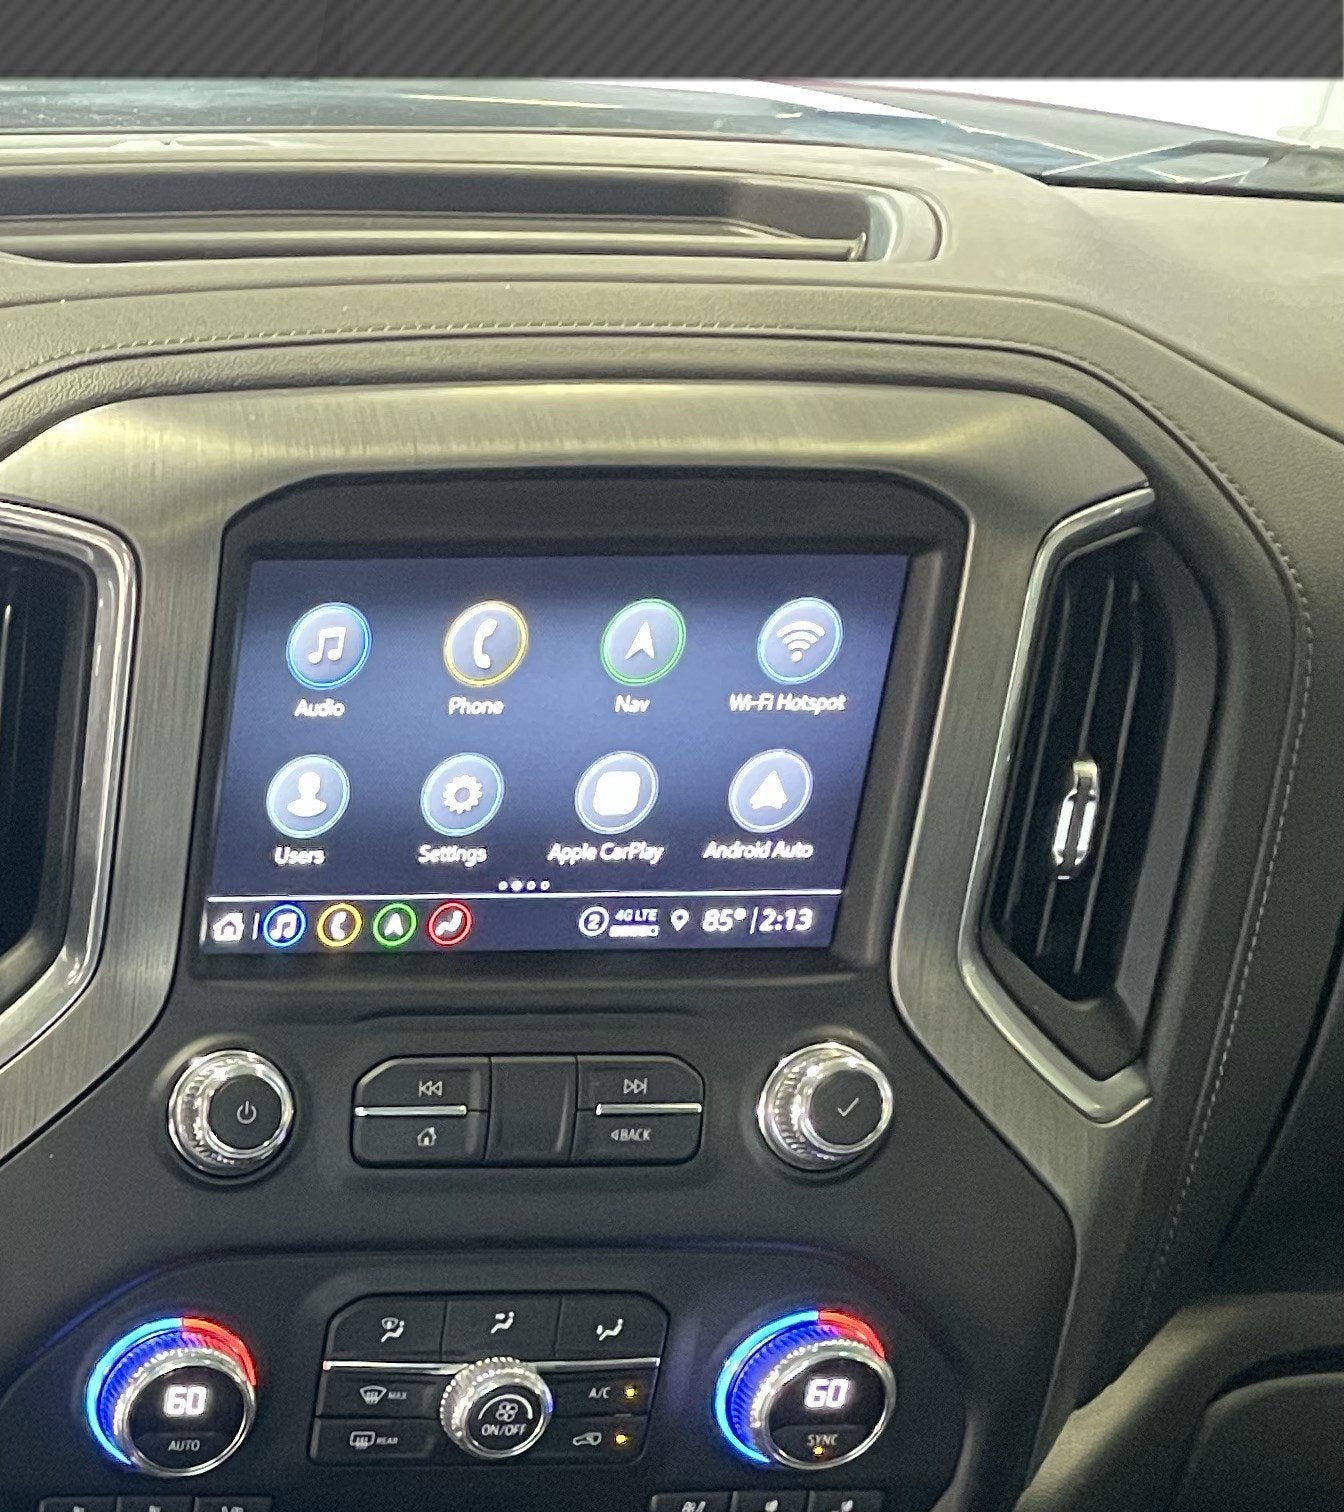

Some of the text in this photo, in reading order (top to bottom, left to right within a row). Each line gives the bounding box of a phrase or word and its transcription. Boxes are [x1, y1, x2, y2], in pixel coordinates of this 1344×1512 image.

[293, 698, 346, 718] Audio
[448, 696, 505, 715] Phone
[613, 694, 651, 713] Nav
[728, 693, 847, 715] Wi-Fi Hotspot
[274, 846, 326, 866] Users
[418, 844, 488, 868] Settings
[546, 842, 665, 865] Apple CarPlay
[702, 841, 814, 860] Android Auto
[759, 907, 813, 931] 2:13
[620, 1128, 652, 1141] BACK
[164, 1385, 209, 1417] 60
[589, 1387, 611, 1399] A/C
[804, 1378, 849, 1408] 60
[481, 1424, 527, 1436] ON/OFF
[168, 1440, 201, 1452] AUTO
[807, 1434, 838, 1446] SYNC
